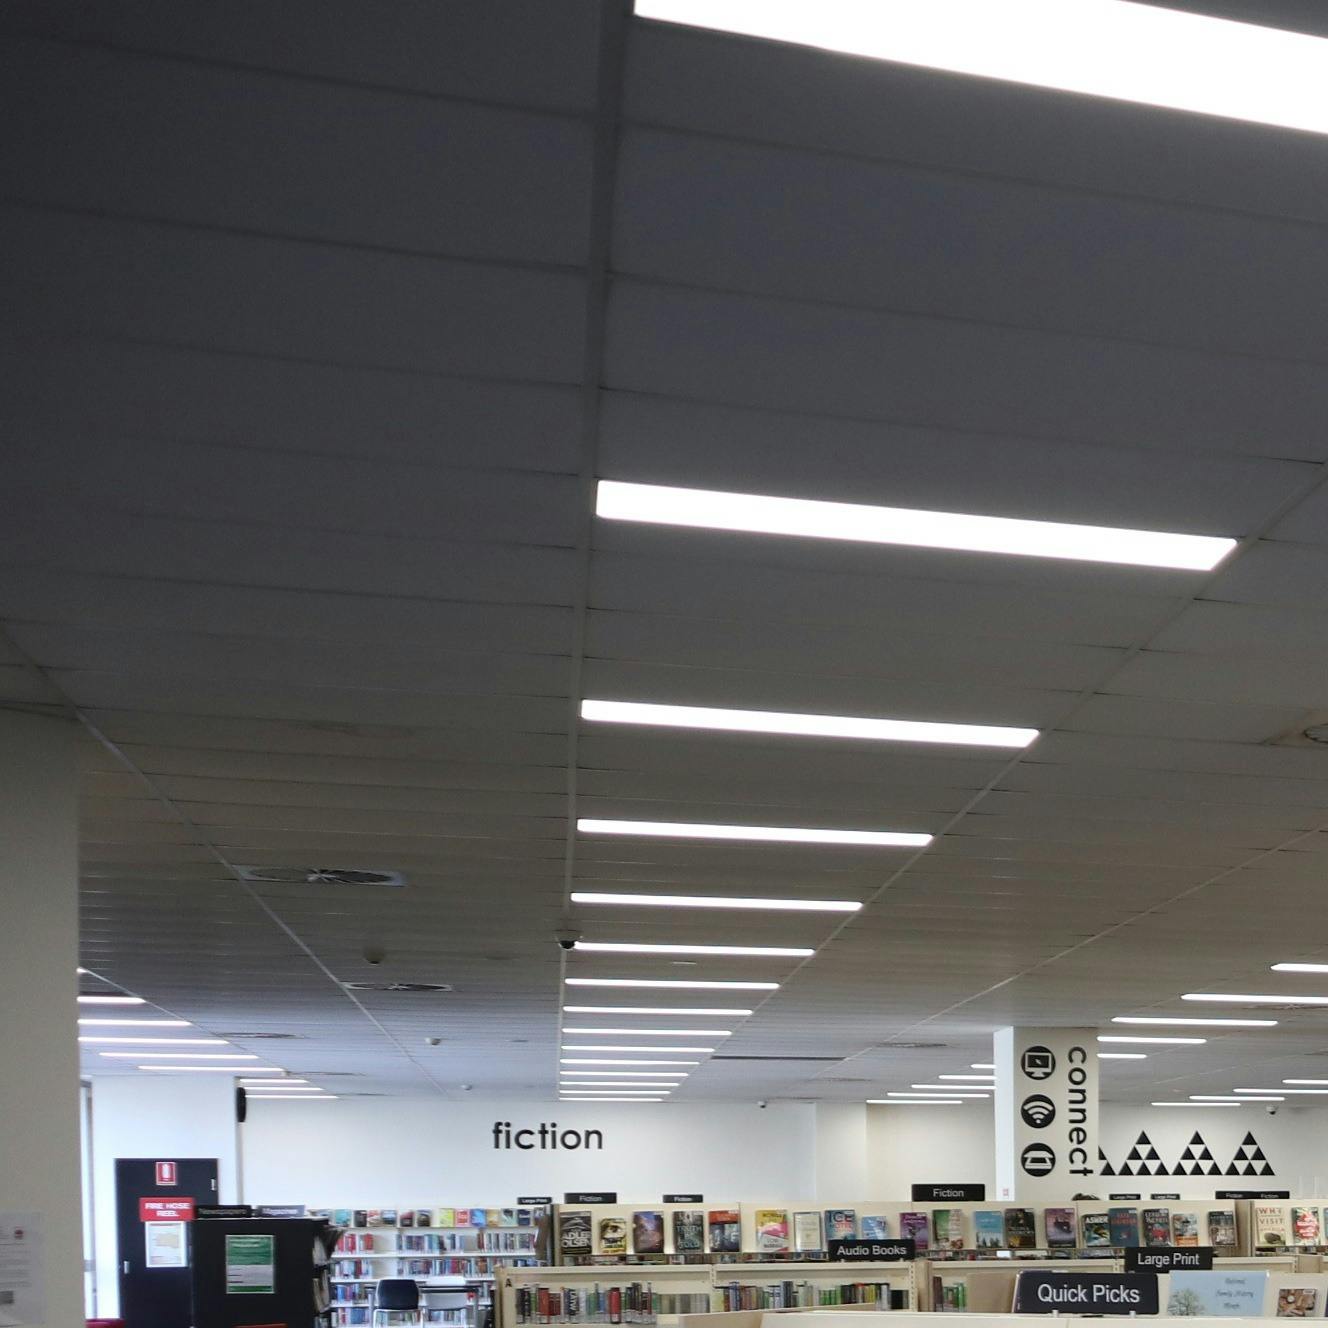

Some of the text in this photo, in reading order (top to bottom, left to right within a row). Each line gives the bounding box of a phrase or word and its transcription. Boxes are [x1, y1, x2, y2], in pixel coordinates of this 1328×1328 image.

[1068, 1046, 1093, 1176] connect
[493, 1122, 602, 1149] fiction
[933, 1189, 964, 1197] Fiction
[562, 1232, 591, 1240] ADLER
[837, 1246, 906, 1255] Audio Books
[1138, 1253, 1199, 1267] Large Print
[1037, 1283, 1140, 1305] Quick Picks
